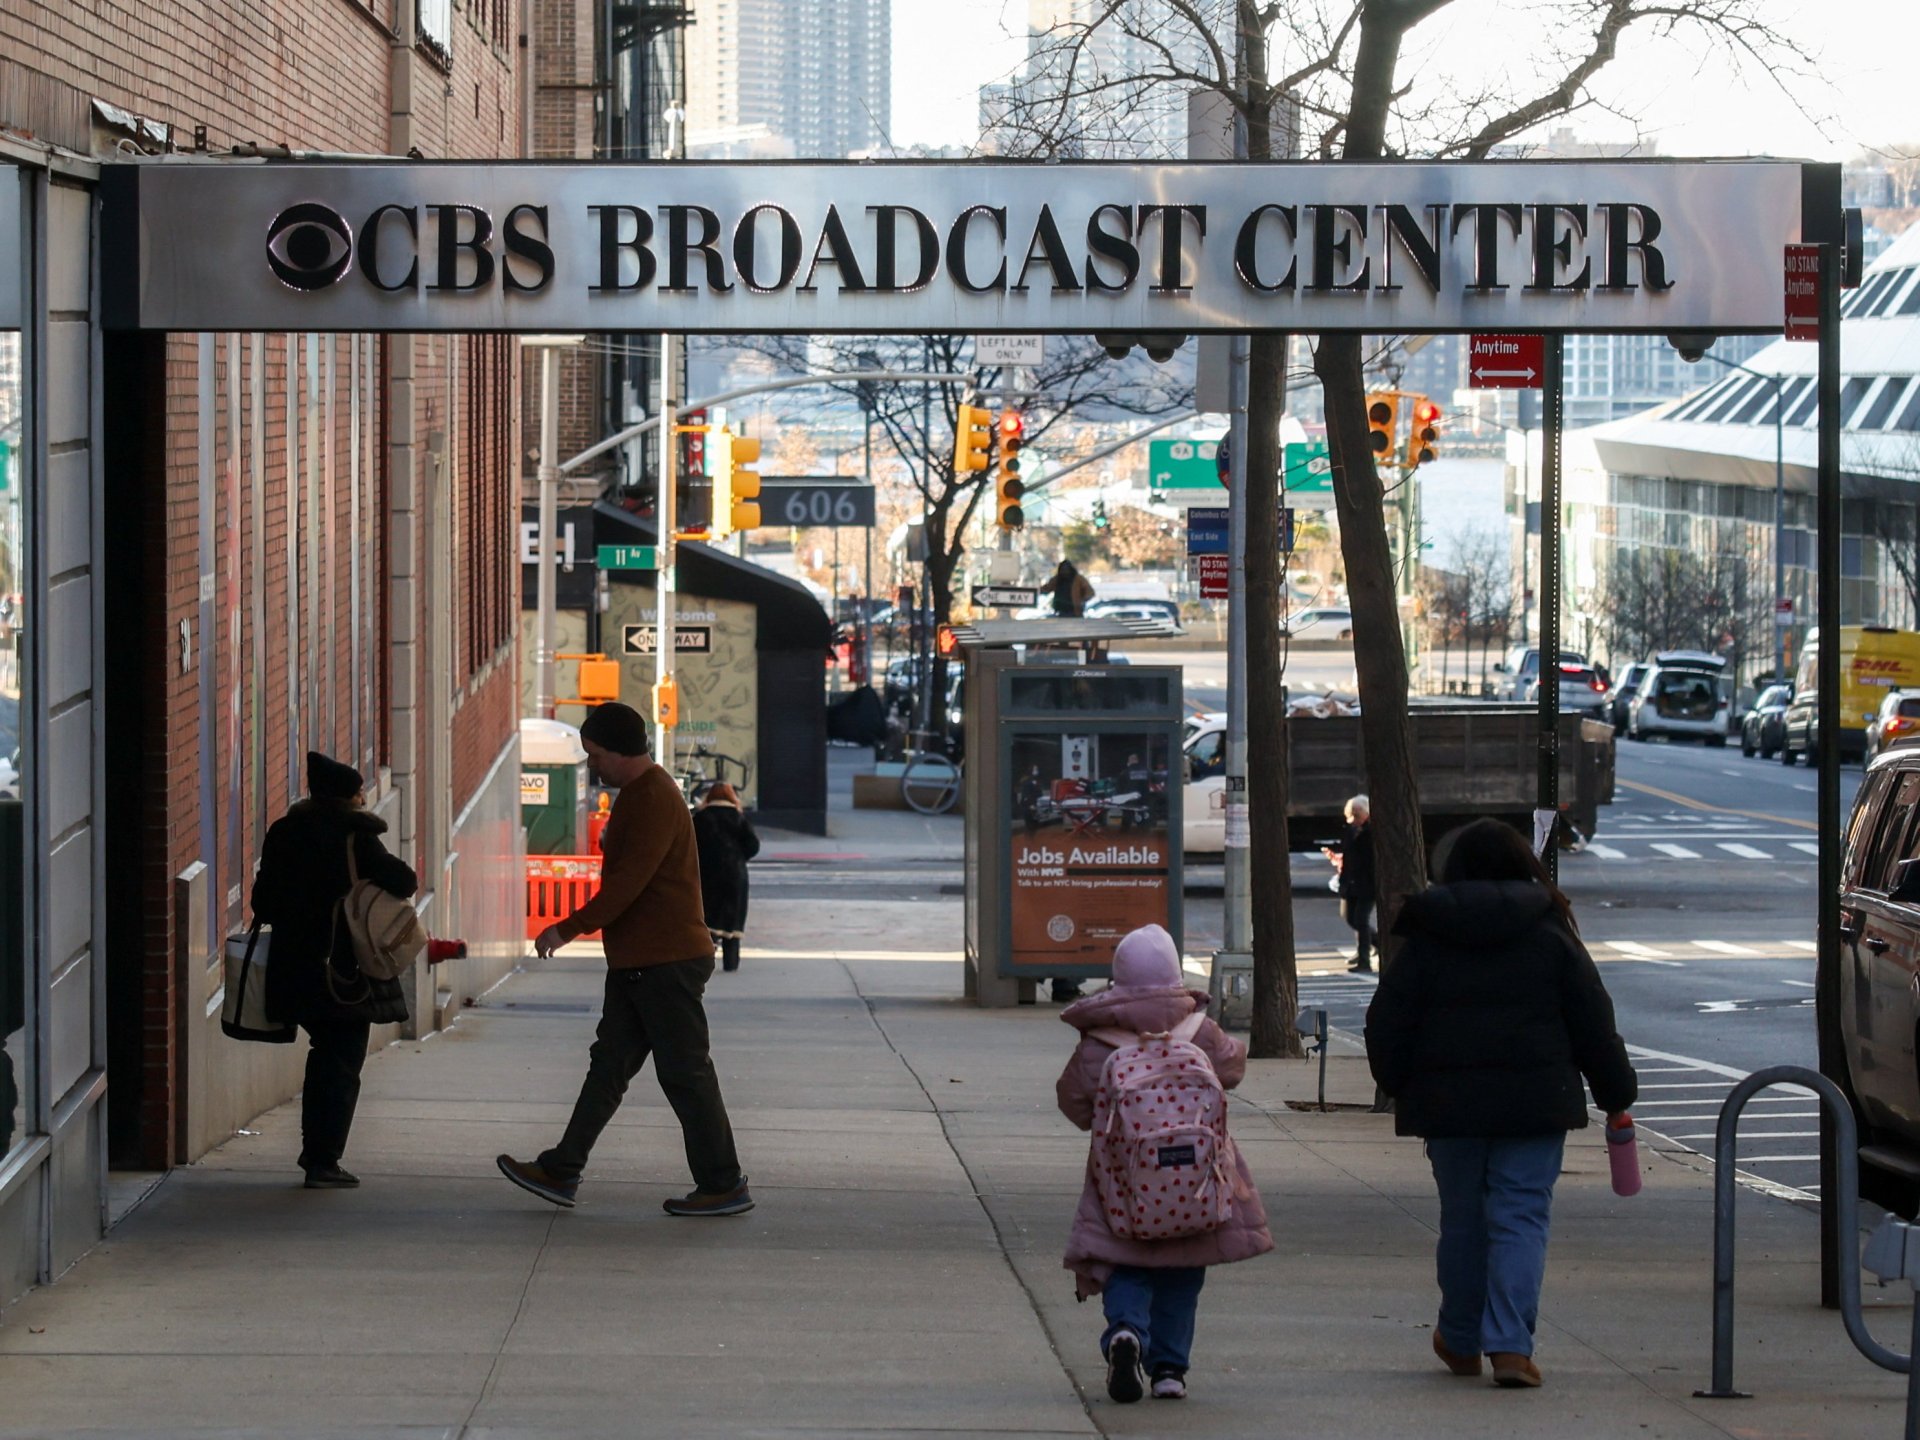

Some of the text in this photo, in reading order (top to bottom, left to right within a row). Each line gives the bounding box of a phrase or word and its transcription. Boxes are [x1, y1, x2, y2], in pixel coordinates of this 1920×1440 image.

[358, 201, 1676, 294] CBS BROADCAST CENTER
[1786, 256, 1797, 272] NO
[1787, 279, 1815, 298] Anytime
[981, 338, 1038, 348] LEFT LANE
[1474, 340, 1519, 357] Anytime
[996, 350, 1023, 360] ONLY
[785, 490, 857, 524] 606
[1190, 511, 1219, 519] Columbus
[1190, 532, 1219, 541] East Side
[615, 548, 641, 566] 11 Av
[1201, 560, 1211, 568] NO
[1202, 570, 1228, 580] Anytime
[981, 591, 1030, 601] ONE WAY
[640, 609, 717, 622] Wcome
[675, 632, 700, 645] WAY
[1853, 659, 1902, 672] DHL
[1018, 846, 1160, 865] Jobs Available
[1018, 868, 1065, 877] With NYC
[1071, 880, 1093, 888] hiring
[1093, 879, 1138, 888] professional
[1138, 879, 1162, 888] today!
